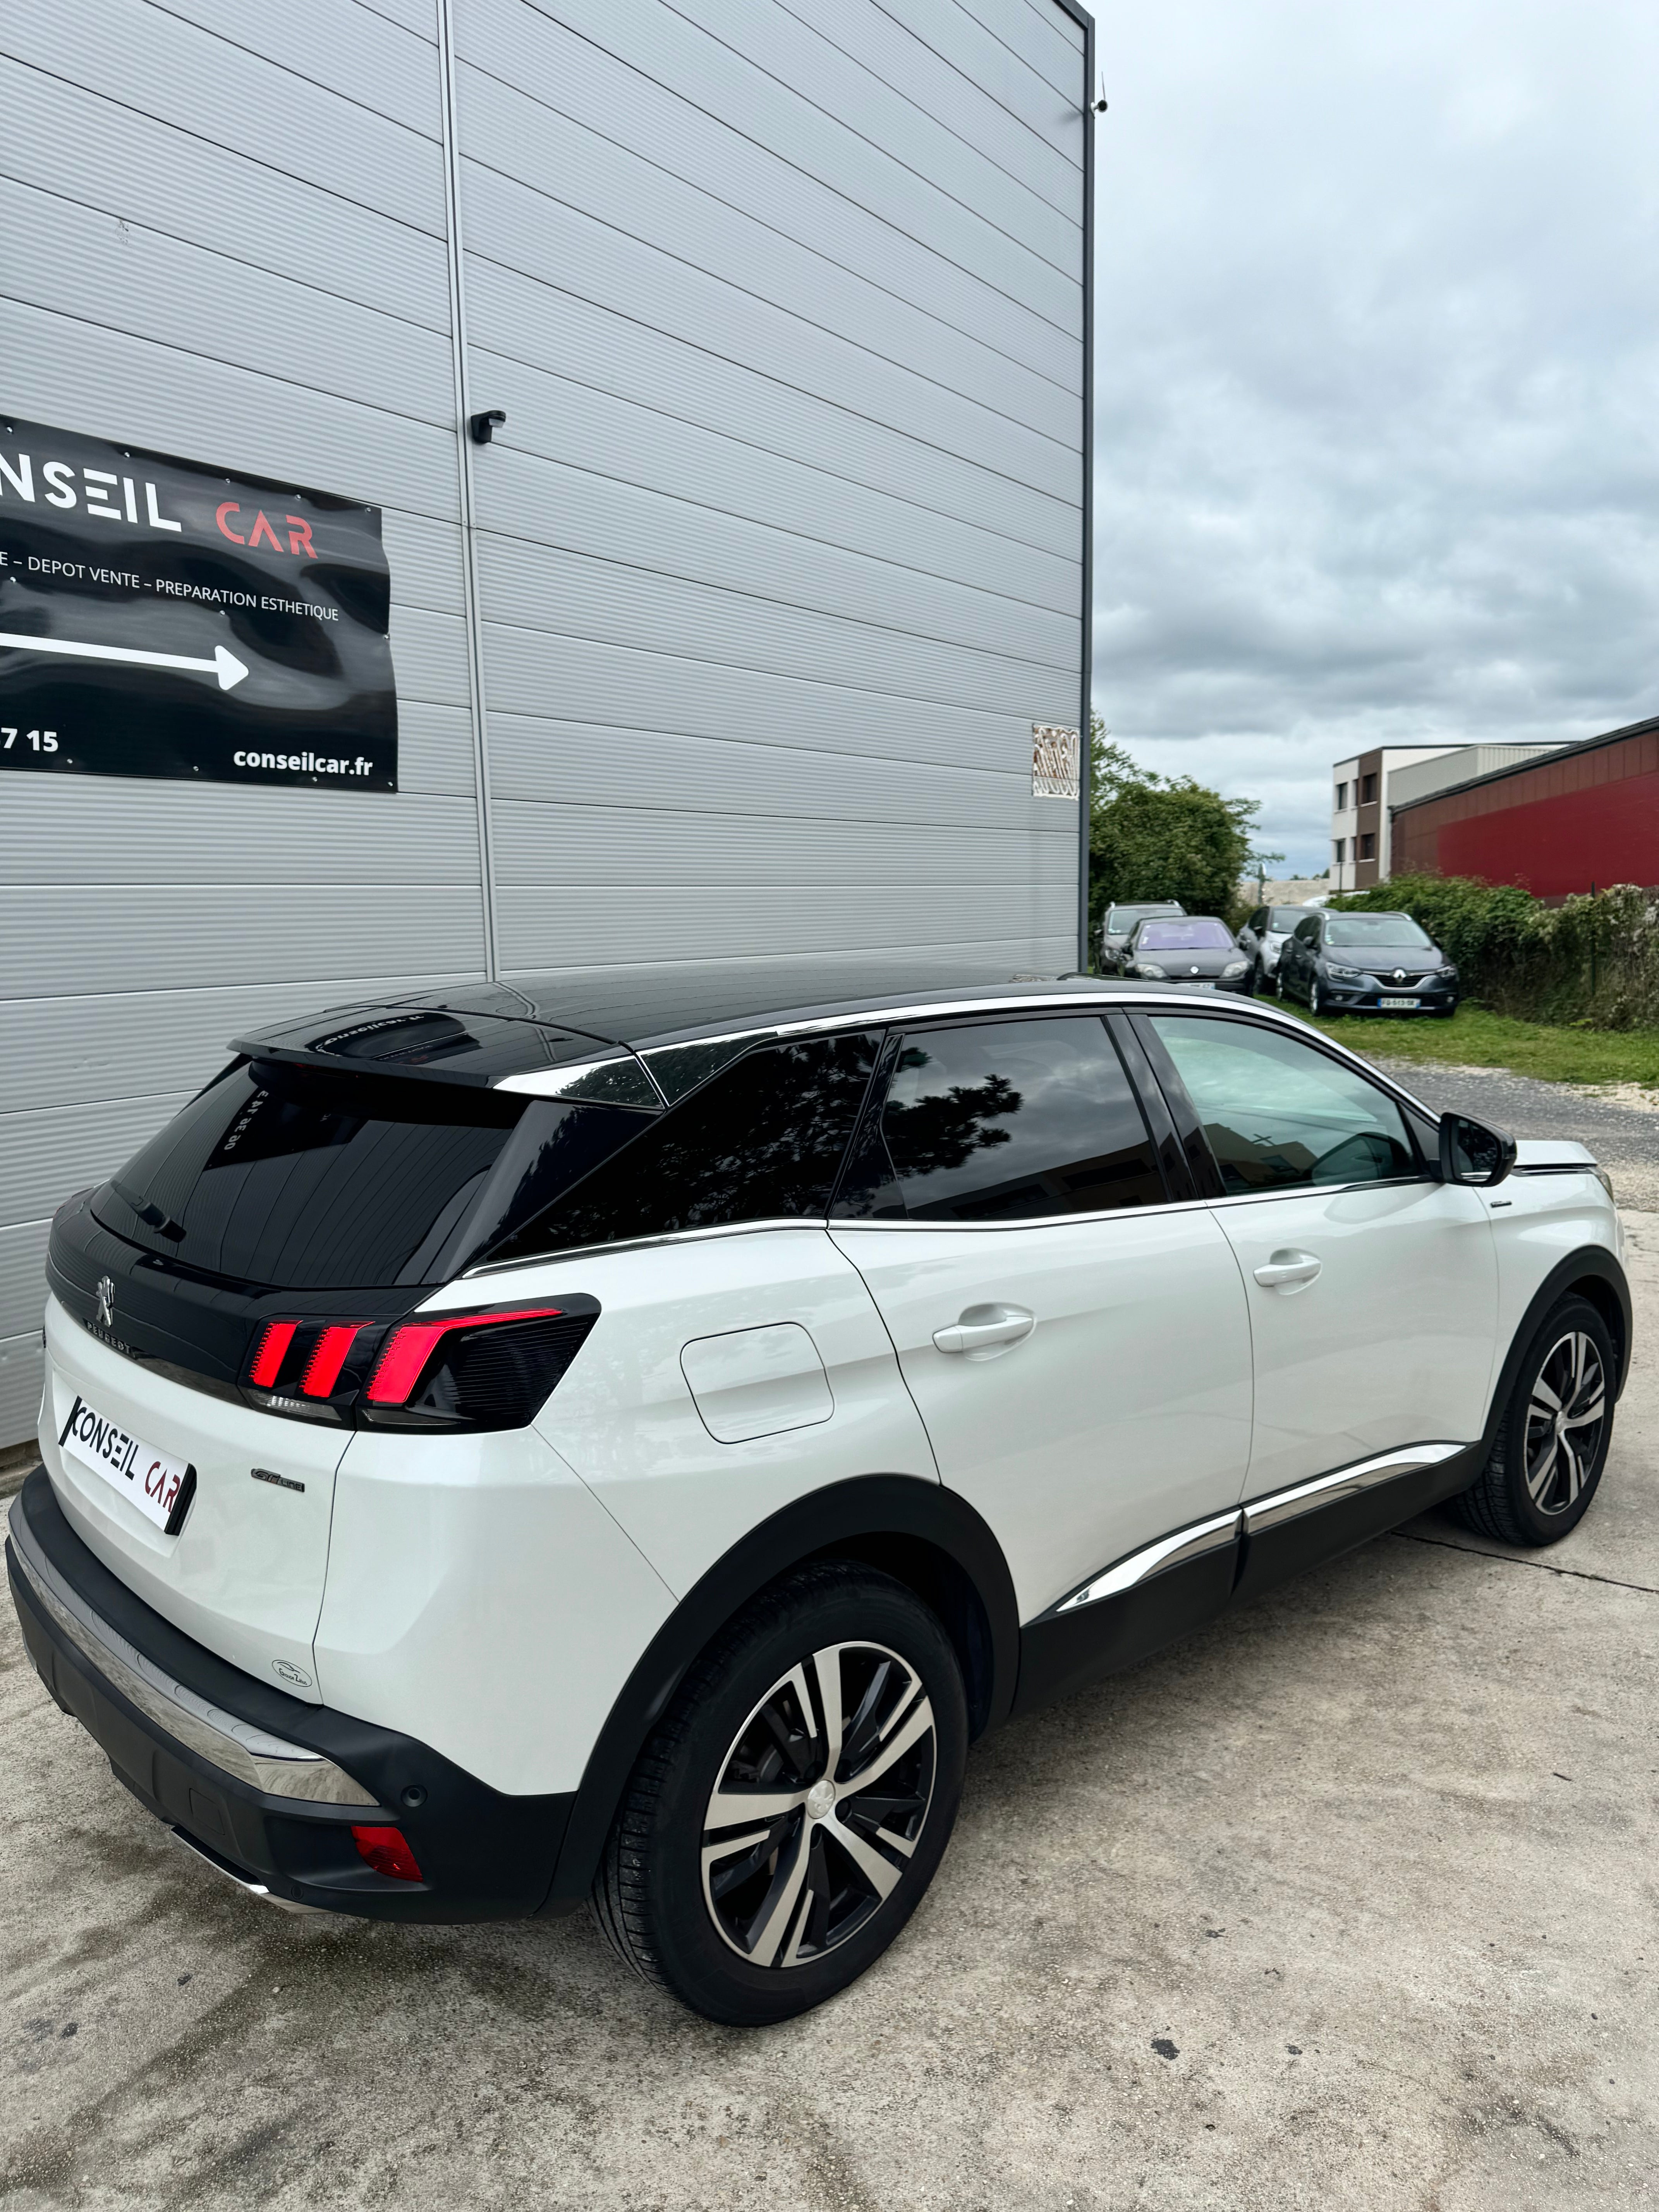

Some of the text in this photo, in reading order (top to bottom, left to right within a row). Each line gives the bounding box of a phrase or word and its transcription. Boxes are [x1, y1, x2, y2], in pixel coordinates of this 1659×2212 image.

[216, 502, 318, 558] CAR
[28, 557, 86, 578] DEPOT
[89, 567, 140, 588] VENTE
[156, 579, 257, 607] PREPARATION
[261, 598, 338, 620] ESTHETIQUE
[27, 730, 58, 752] 15
[234, 750, 373, 775] conseilcar.fr
[88, 1321, 130, 1353] PEUGEOT
[72, 1407, 180, 1513] CONSEIL CAR
